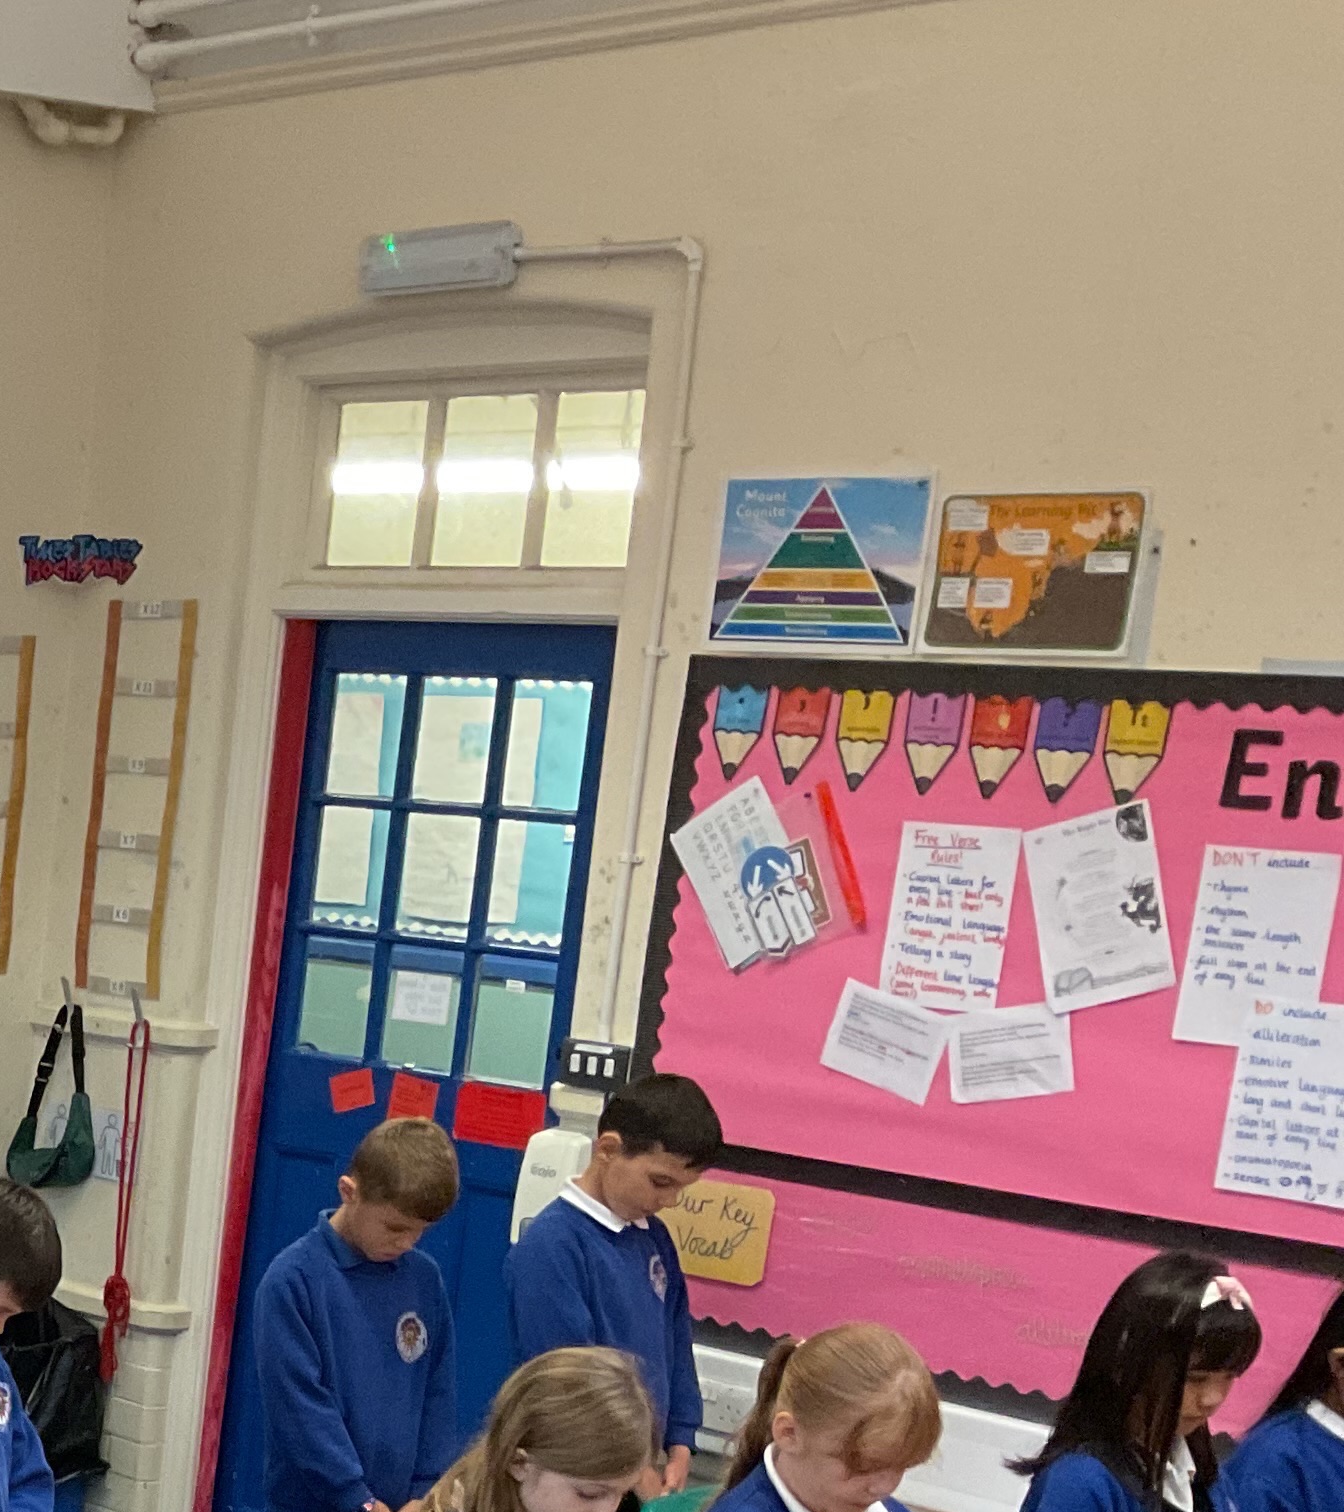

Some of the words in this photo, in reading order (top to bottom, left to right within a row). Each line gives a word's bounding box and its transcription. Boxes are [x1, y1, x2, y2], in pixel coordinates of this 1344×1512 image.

[745, 489, 787, 501] Mount
[1212, 849, 1261, 867] DON'T
[1255, 999, 1274, 1015] DO
[719, 1195, 758, 1249] Key
[676, 1225, 733, 1261] Vocab
